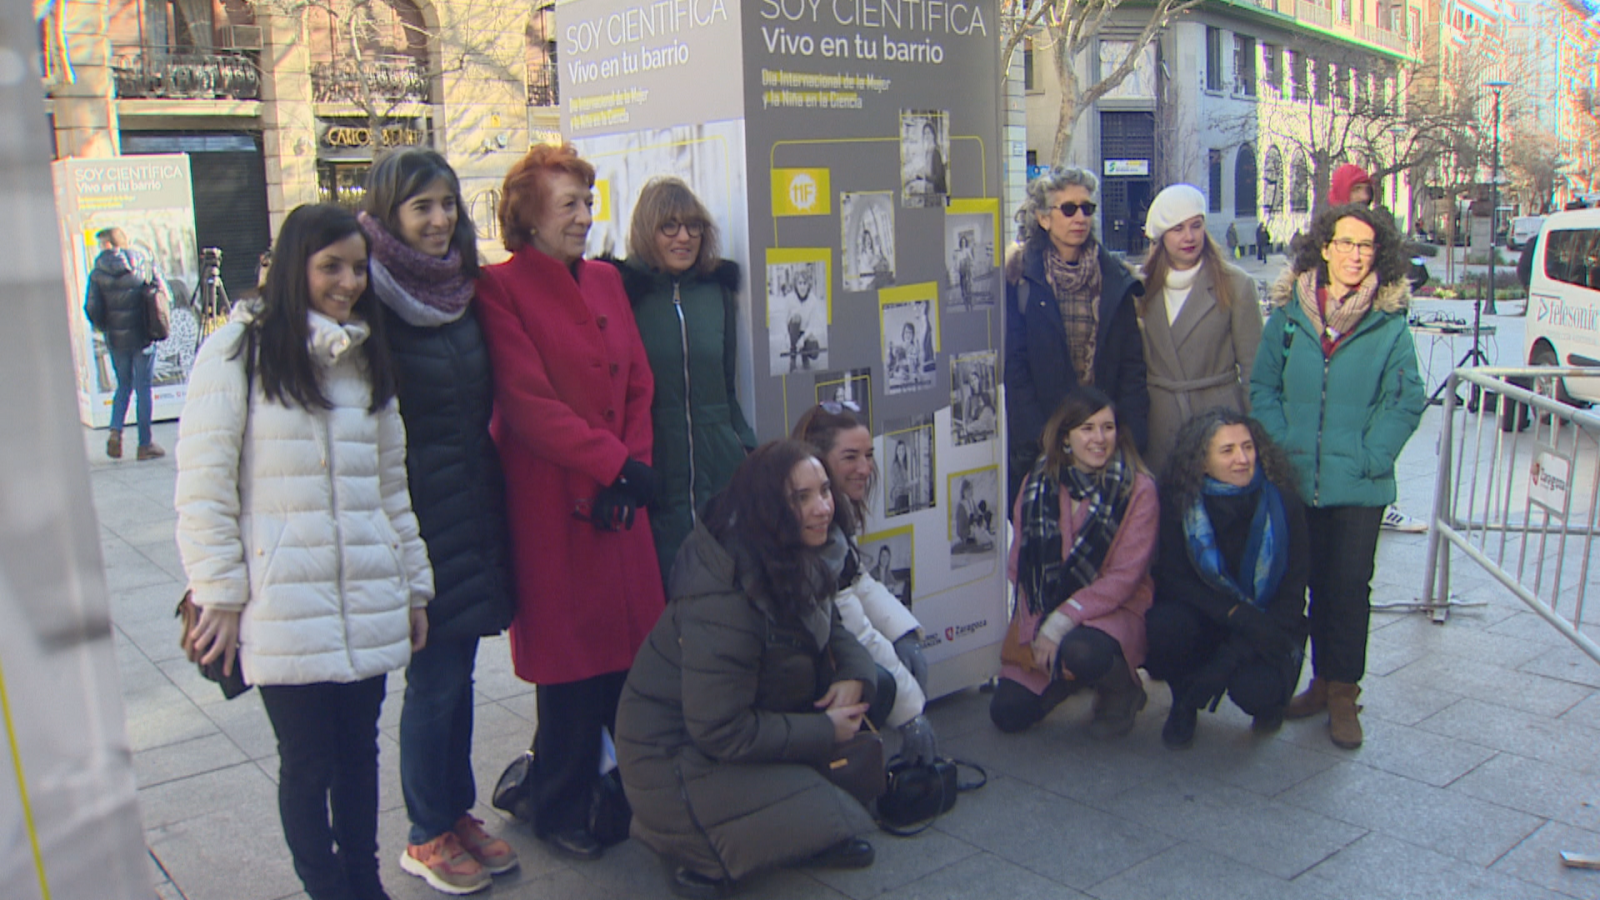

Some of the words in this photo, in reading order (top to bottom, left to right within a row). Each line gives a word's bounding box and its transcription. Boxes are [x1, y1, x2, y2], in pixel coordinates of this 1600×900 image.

[760, 0, 819, 22] SOY
[567, 18, 603, 56] SOY
[761, 26, 815, 56] Vivo
[820, 35, 849, 58] en
[854, 34, 878, 60] tu
[884, 34, 945, 64] barrio
[568, 59, 599, 85] Vivo
[601, 56, 620, 79] en
[622, 50, 639, 75] tu
[642, 38, 690, 72] barrio
[843, 72, 855, 89] de
[856, 73, 865, 90] la
[866, 73, 892, 94] Mujer
[770, 89, 780, 107] la
[806, 95, 818, 108] en
[819, 90, 829, 108] la
[830, 90, 863, 109] Ciencia
[74, 167, 105, 181] SOY
[76, 181, 101, 194] Vivo
[131, 179, 163, 192] barrio
[955, 620, 987, 635] Zaragoza
